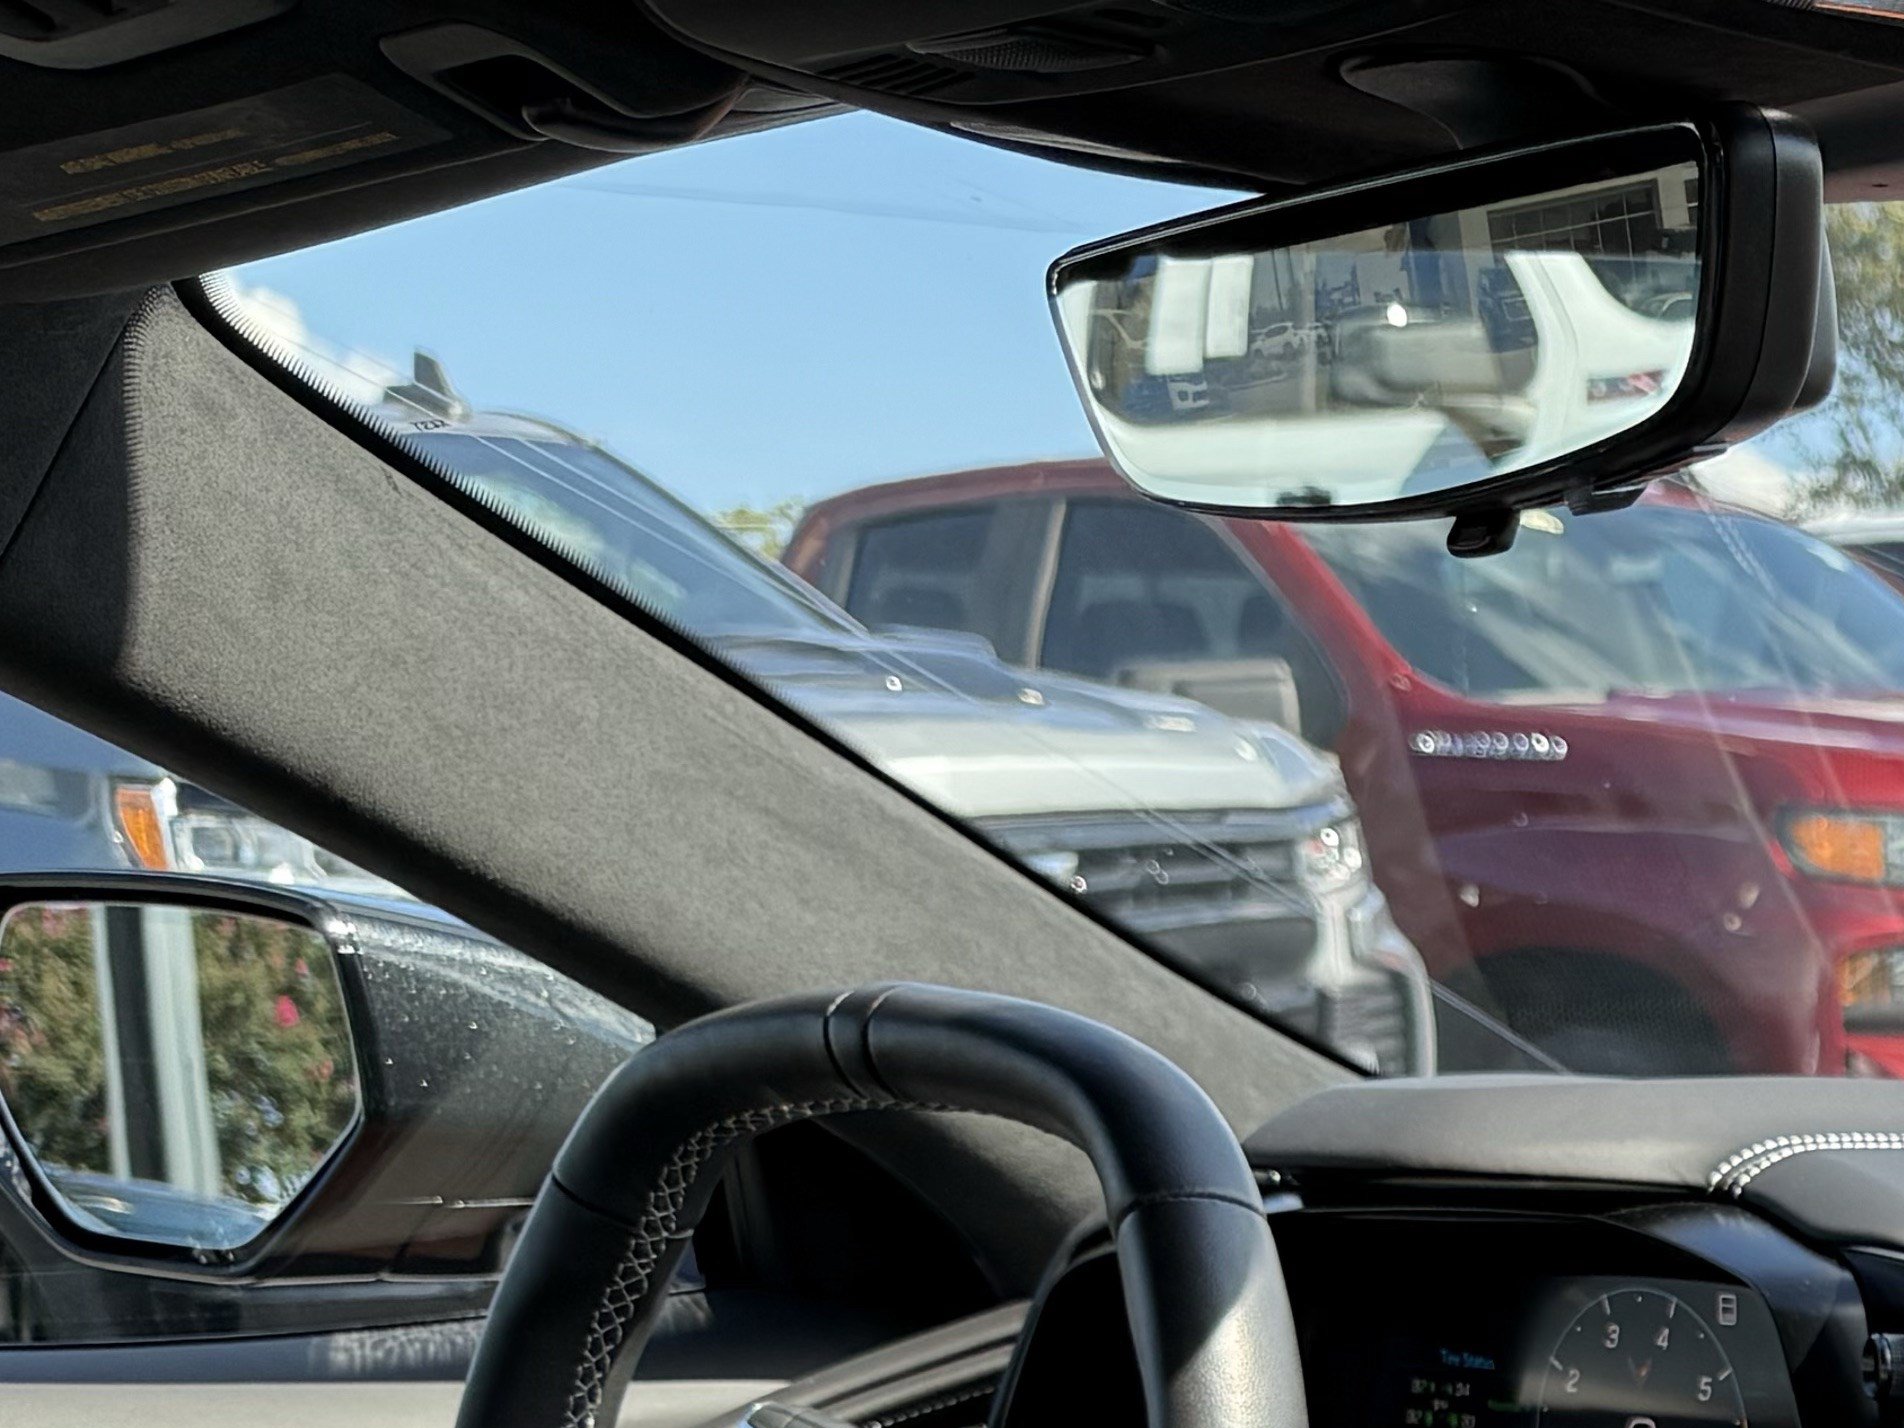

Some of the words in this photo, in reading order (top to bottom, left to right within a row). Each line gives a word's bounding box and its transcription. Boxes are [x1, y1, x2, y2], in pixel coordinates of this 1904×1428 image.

[1603, 1324, 1621, 1350] 3
[1655, 1327, 1670, 1351] 4
[1564, 1369, 1581, 1394] 2
[1697, 1376, 1713, 1402] 5
